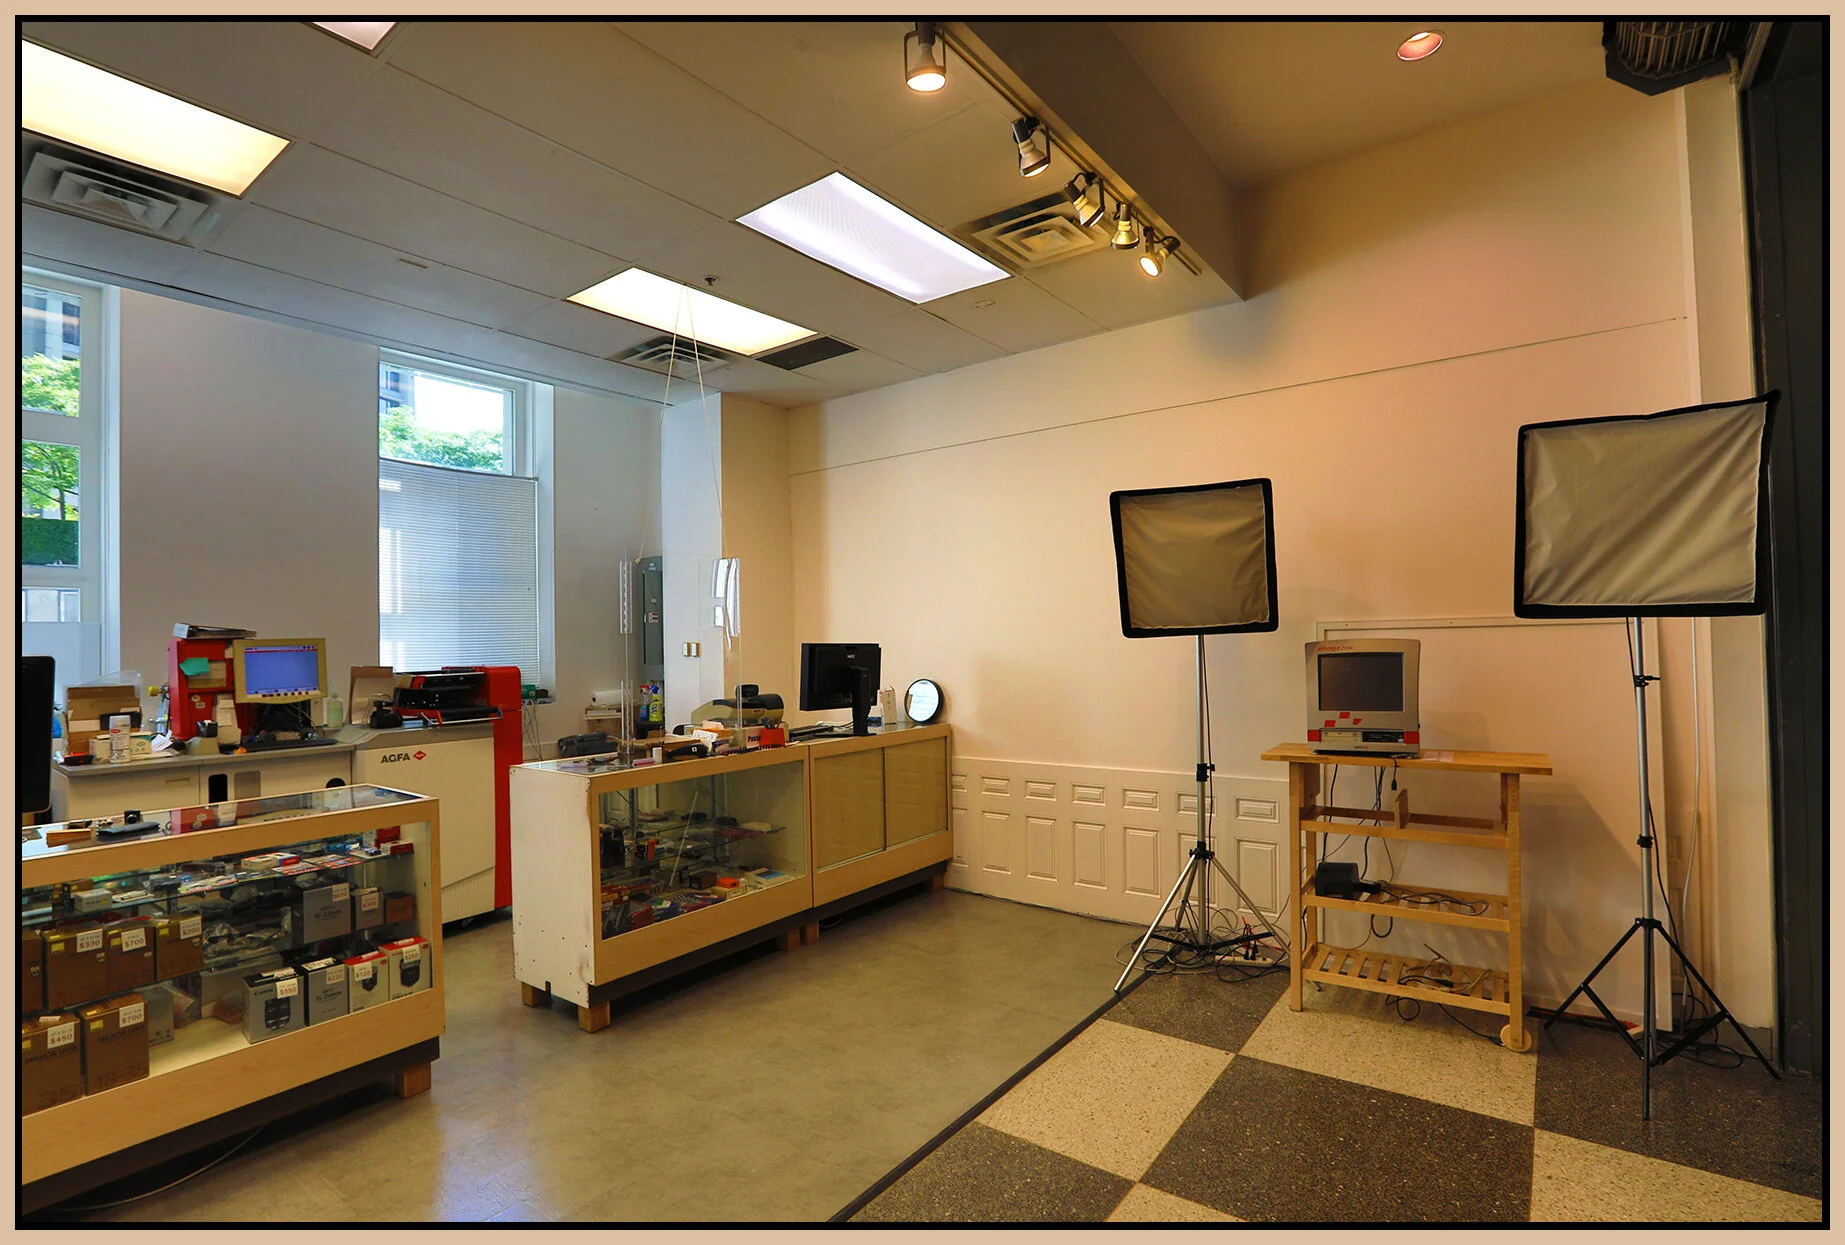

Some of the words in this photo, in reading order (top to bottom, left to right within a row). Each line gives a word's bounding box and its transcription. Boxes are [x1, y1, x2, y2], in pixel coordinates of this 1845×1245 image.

[380, 752, 411, 764] AGFA
[124, 937, 145, 948] $700
[279, 986, 297, 997] $550
[121, 1013, 143, 1025] $700
